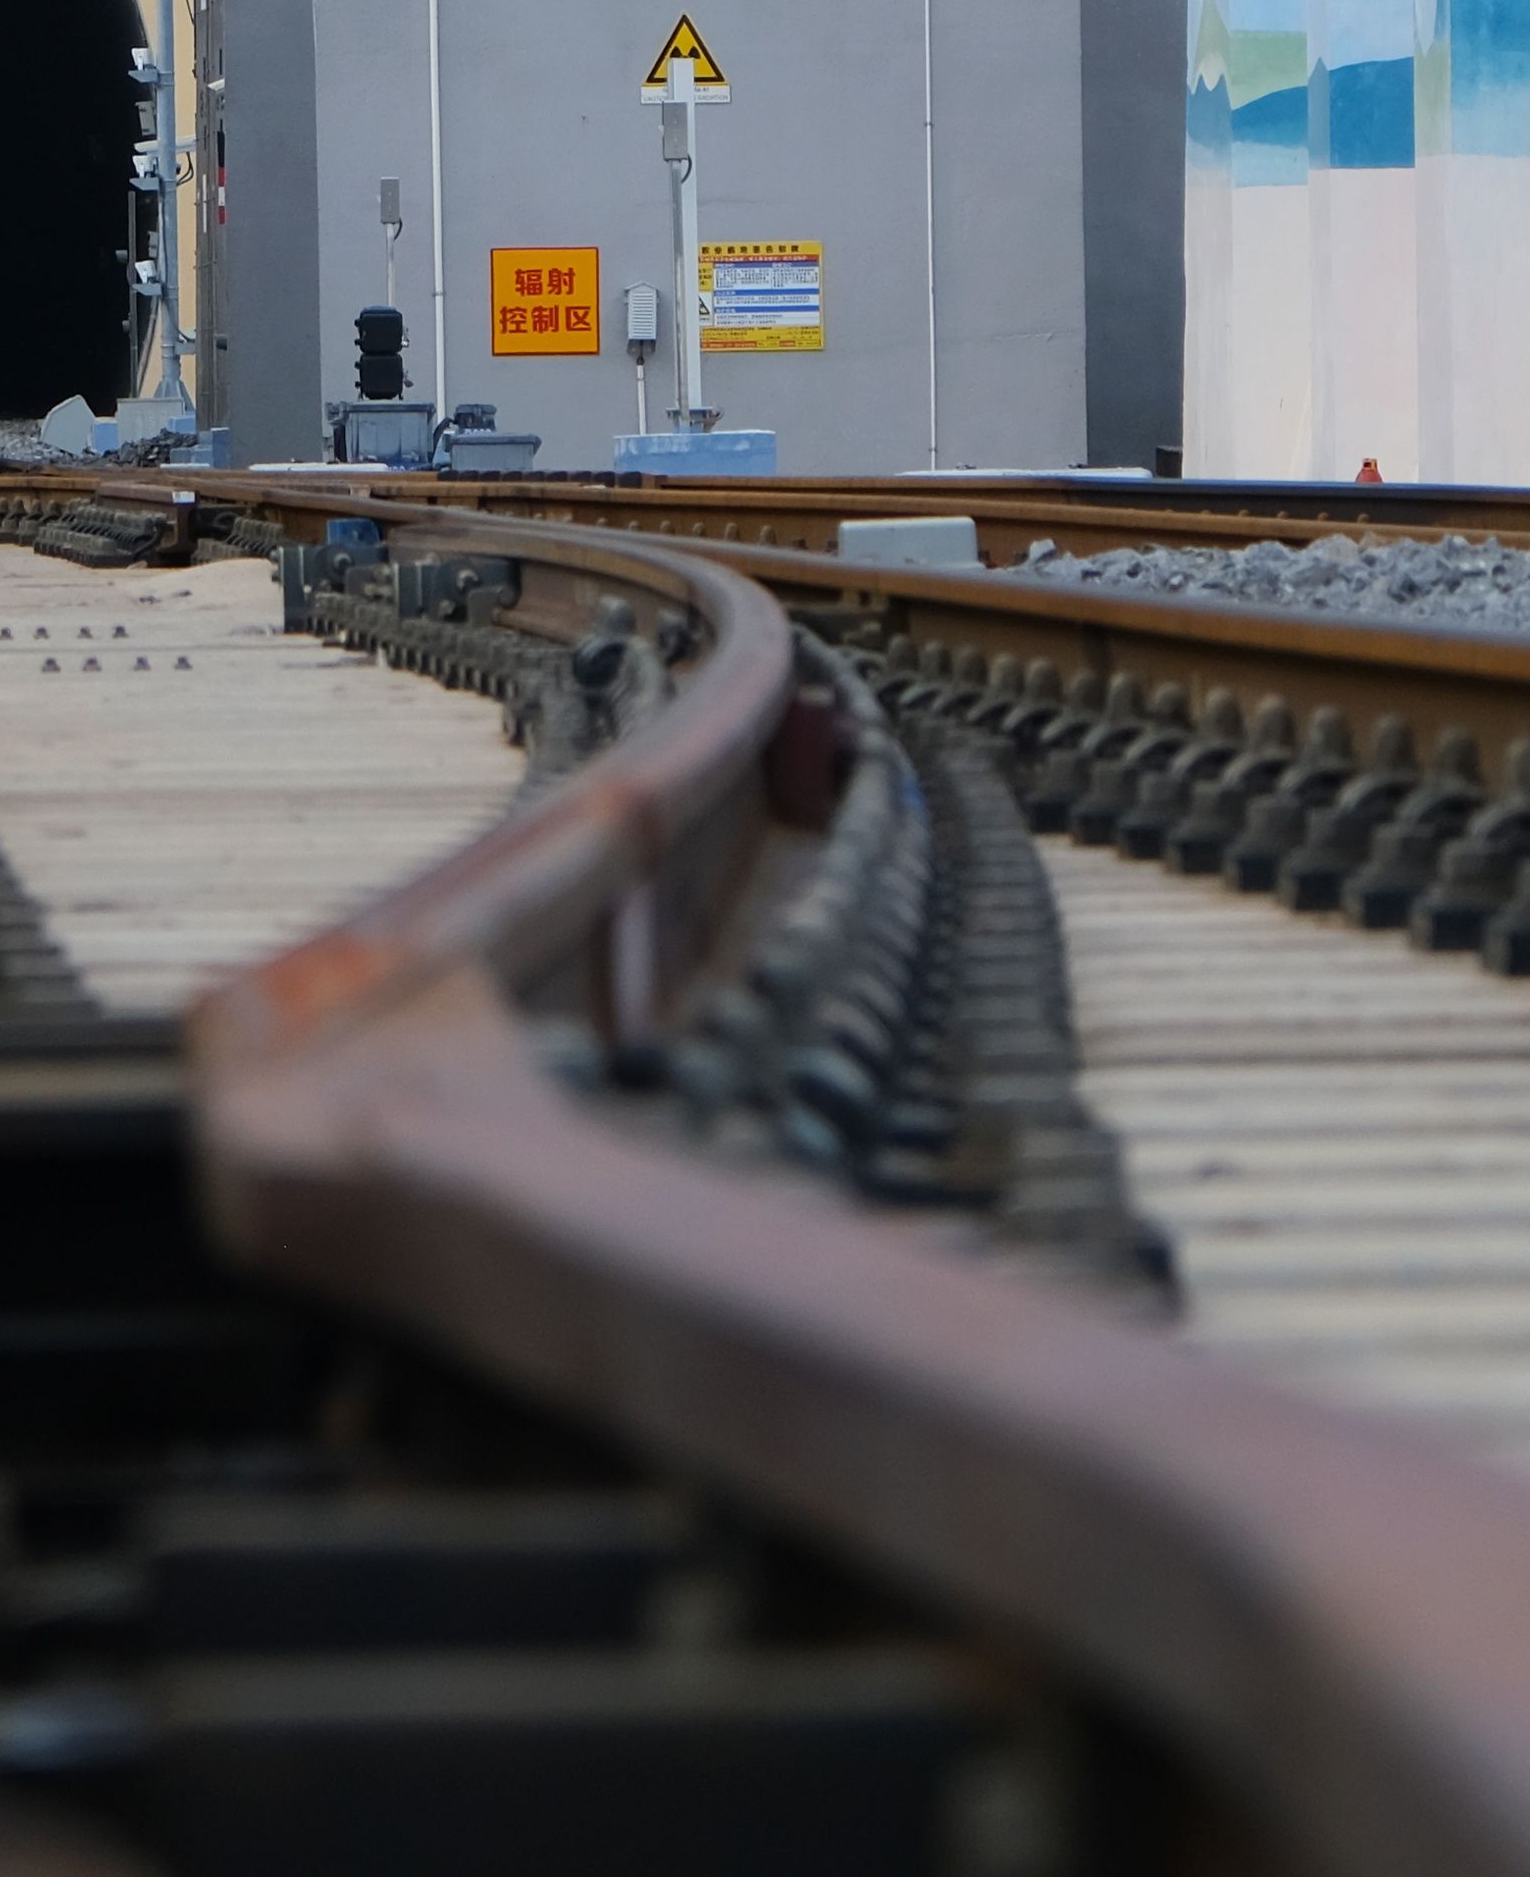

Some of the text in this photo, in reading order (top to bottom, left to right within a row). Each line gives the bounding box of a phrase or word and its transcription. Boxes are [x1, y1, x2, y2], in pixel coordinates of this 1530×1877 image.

[514, 267, 576, 297] 辐射
[499, 305, 592, 334] 控制区
